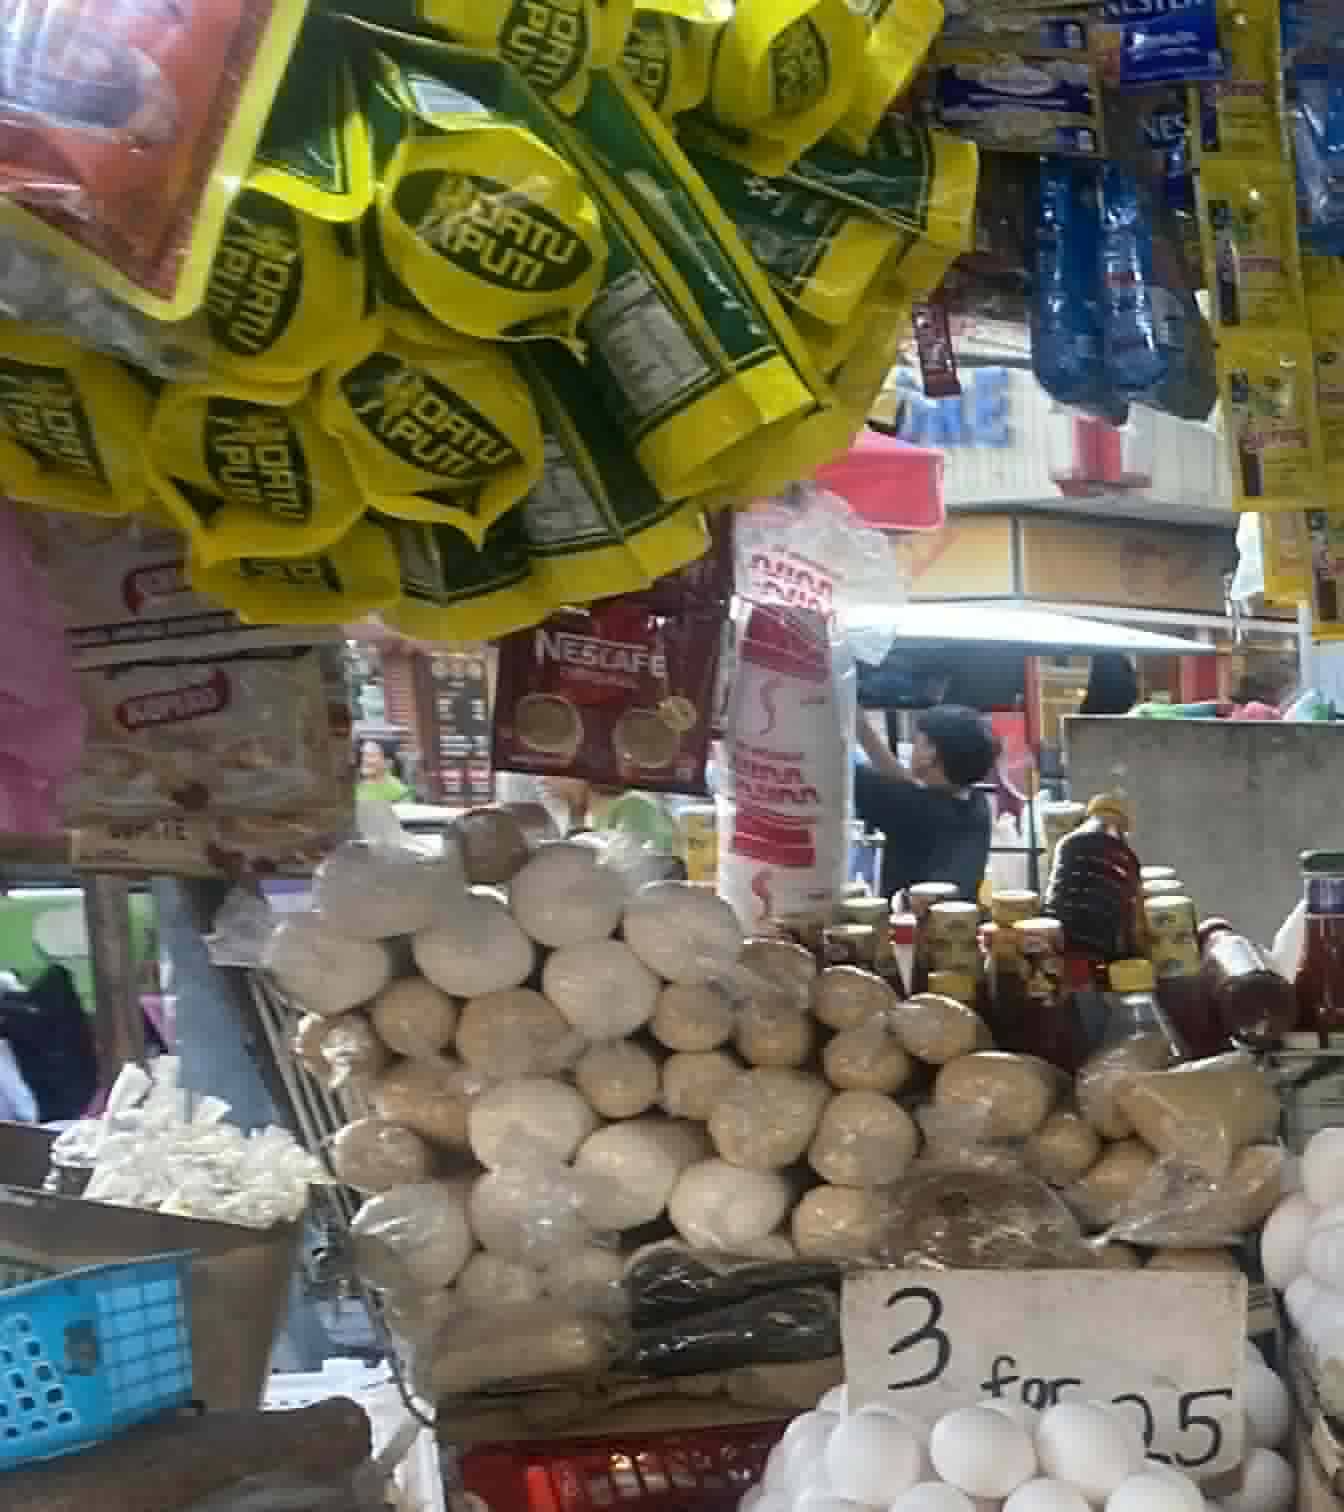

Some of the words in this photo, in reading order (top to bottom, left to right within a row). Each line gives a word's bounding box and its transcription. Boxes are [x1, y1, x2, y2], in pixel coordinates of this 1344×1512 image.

[453, 221, 546, 288] PUTI
[886, 1284, 952, 1391] 3
[979, 1353, 1084, 1411] for
[1109, 1387, 1234, 1468] 25
